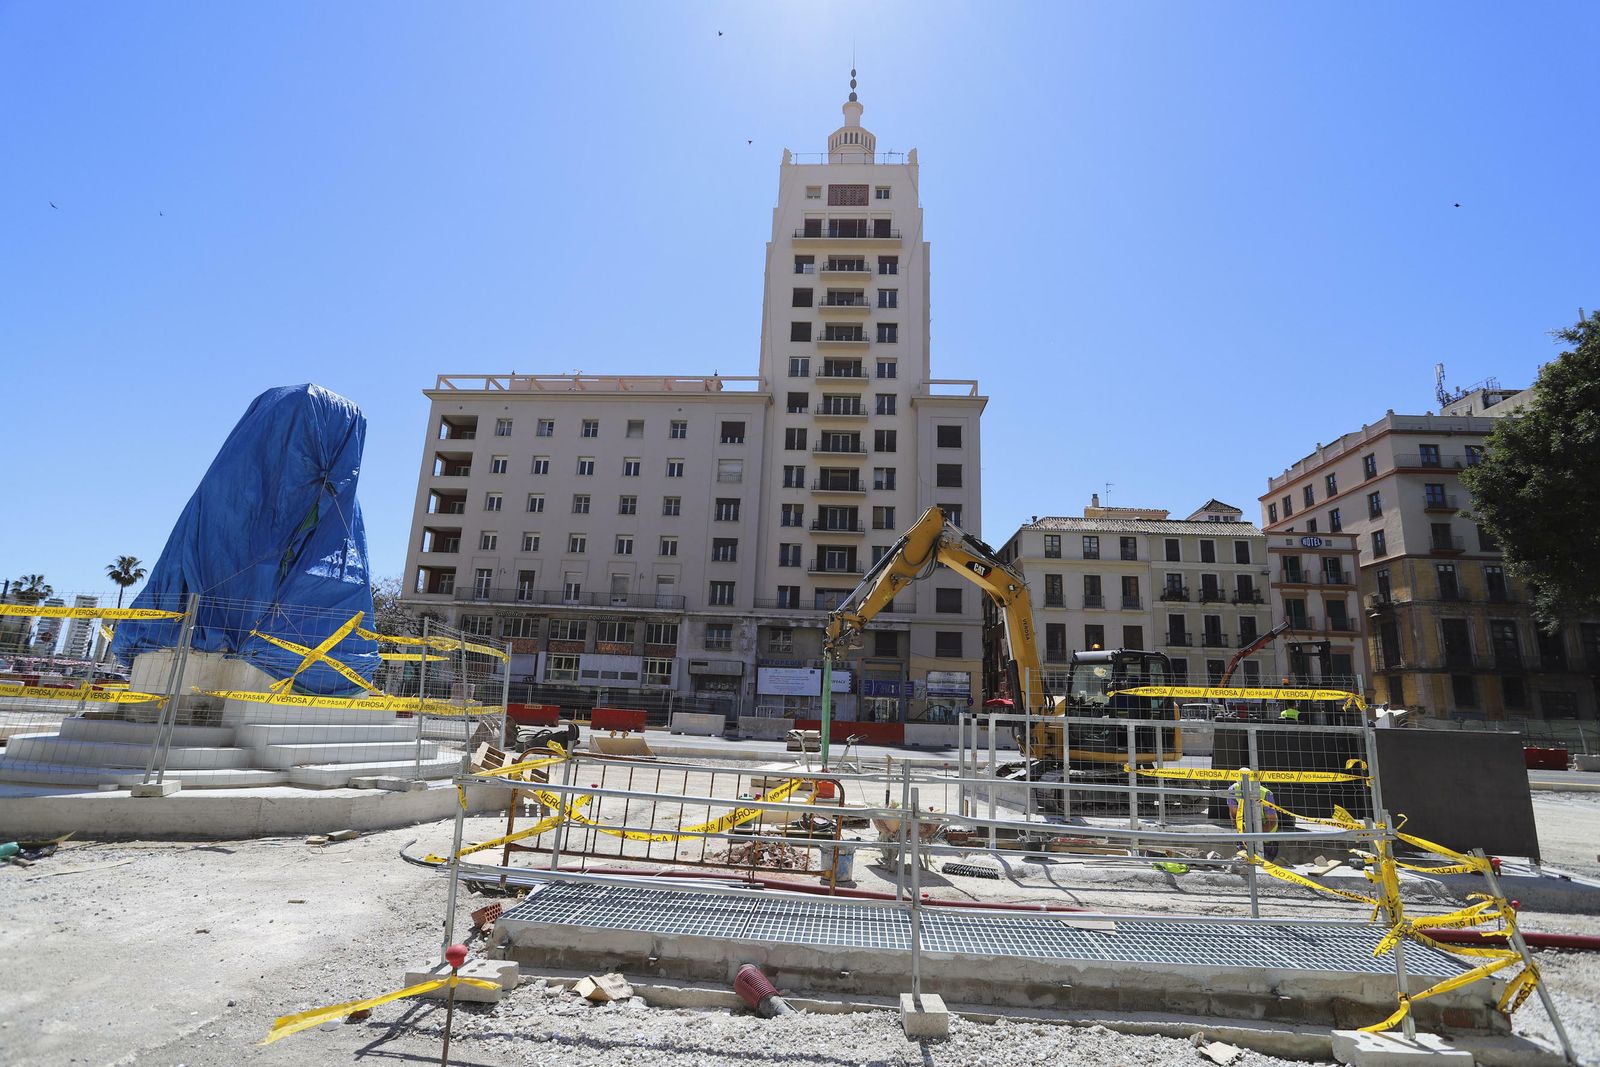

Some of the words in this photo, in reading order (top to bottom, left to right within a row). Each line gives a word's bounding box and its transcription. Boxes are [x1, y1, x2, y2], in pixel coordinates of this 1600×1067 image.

[1302, 537, 1320, 547] HOTEL
[973, 562, 985, 576] CAT
[1022, 617, 1031, 641] VEROSA
[26, 688, 51, 696] VEROSA
[90, 692, 115, 700] VEROSA
[276, 696, 308, 704] VEROSA
[769, 791, 780, 802] NO
[1273, 868, 1285, 878] NO
